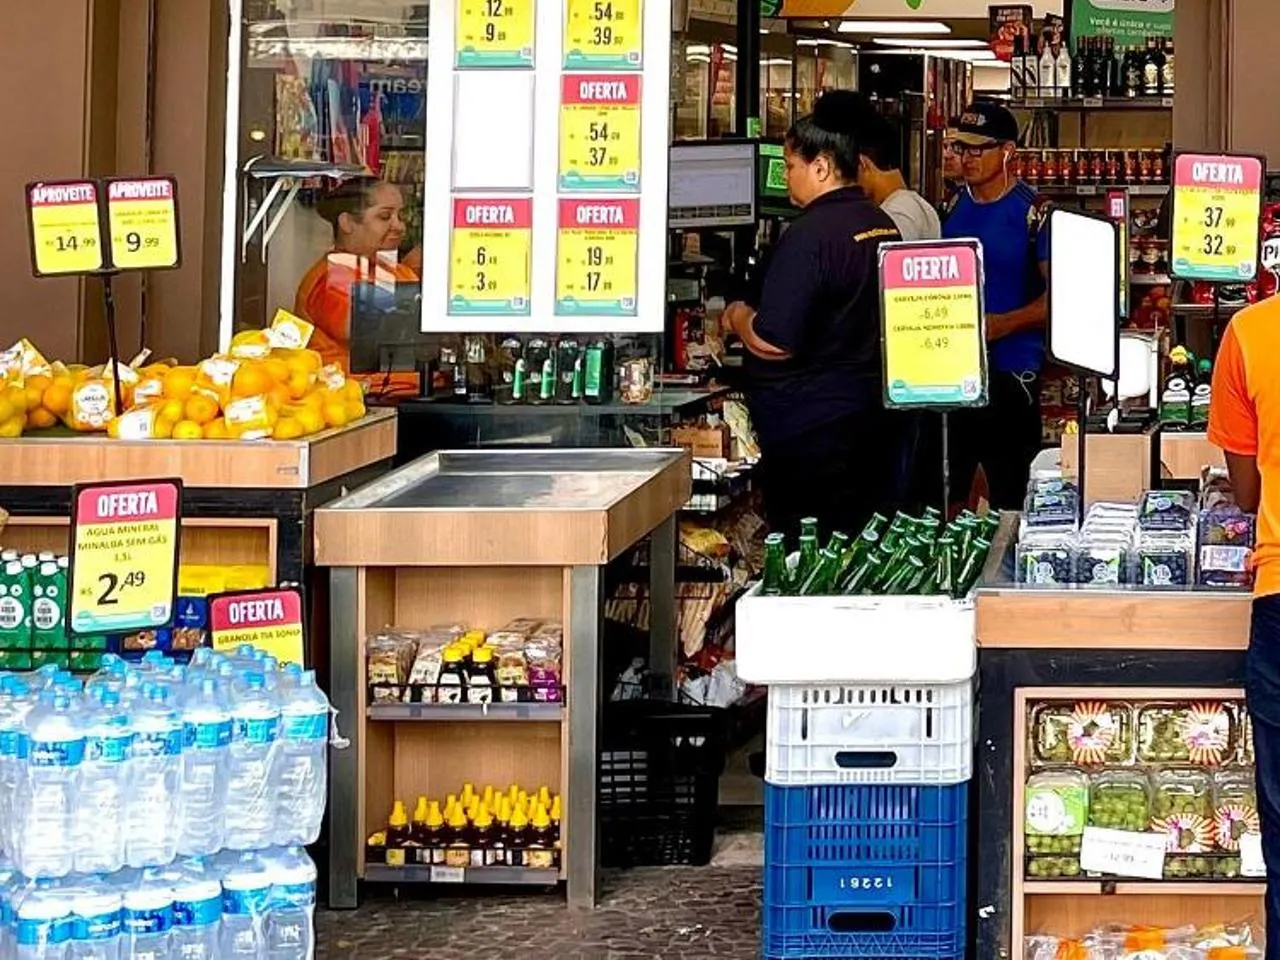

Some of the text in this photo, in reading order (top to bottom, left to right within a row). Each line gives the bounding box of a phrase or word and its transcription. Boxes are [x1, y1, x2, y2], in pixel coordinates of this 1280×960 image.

[580, 81, 628, 100] OFERTA
[1192, 161, 1244, 184] OFERTA
[465, 205, 514, 224] OFERTA
[576, 205, 624, 224] OFERTA
[902, 255, 960, 281] OFERTA
[96, 491, 159, 518] OFERTA
[228, 597, 285, 624] OFERTA
[840, 877, 893, 889] 12261
